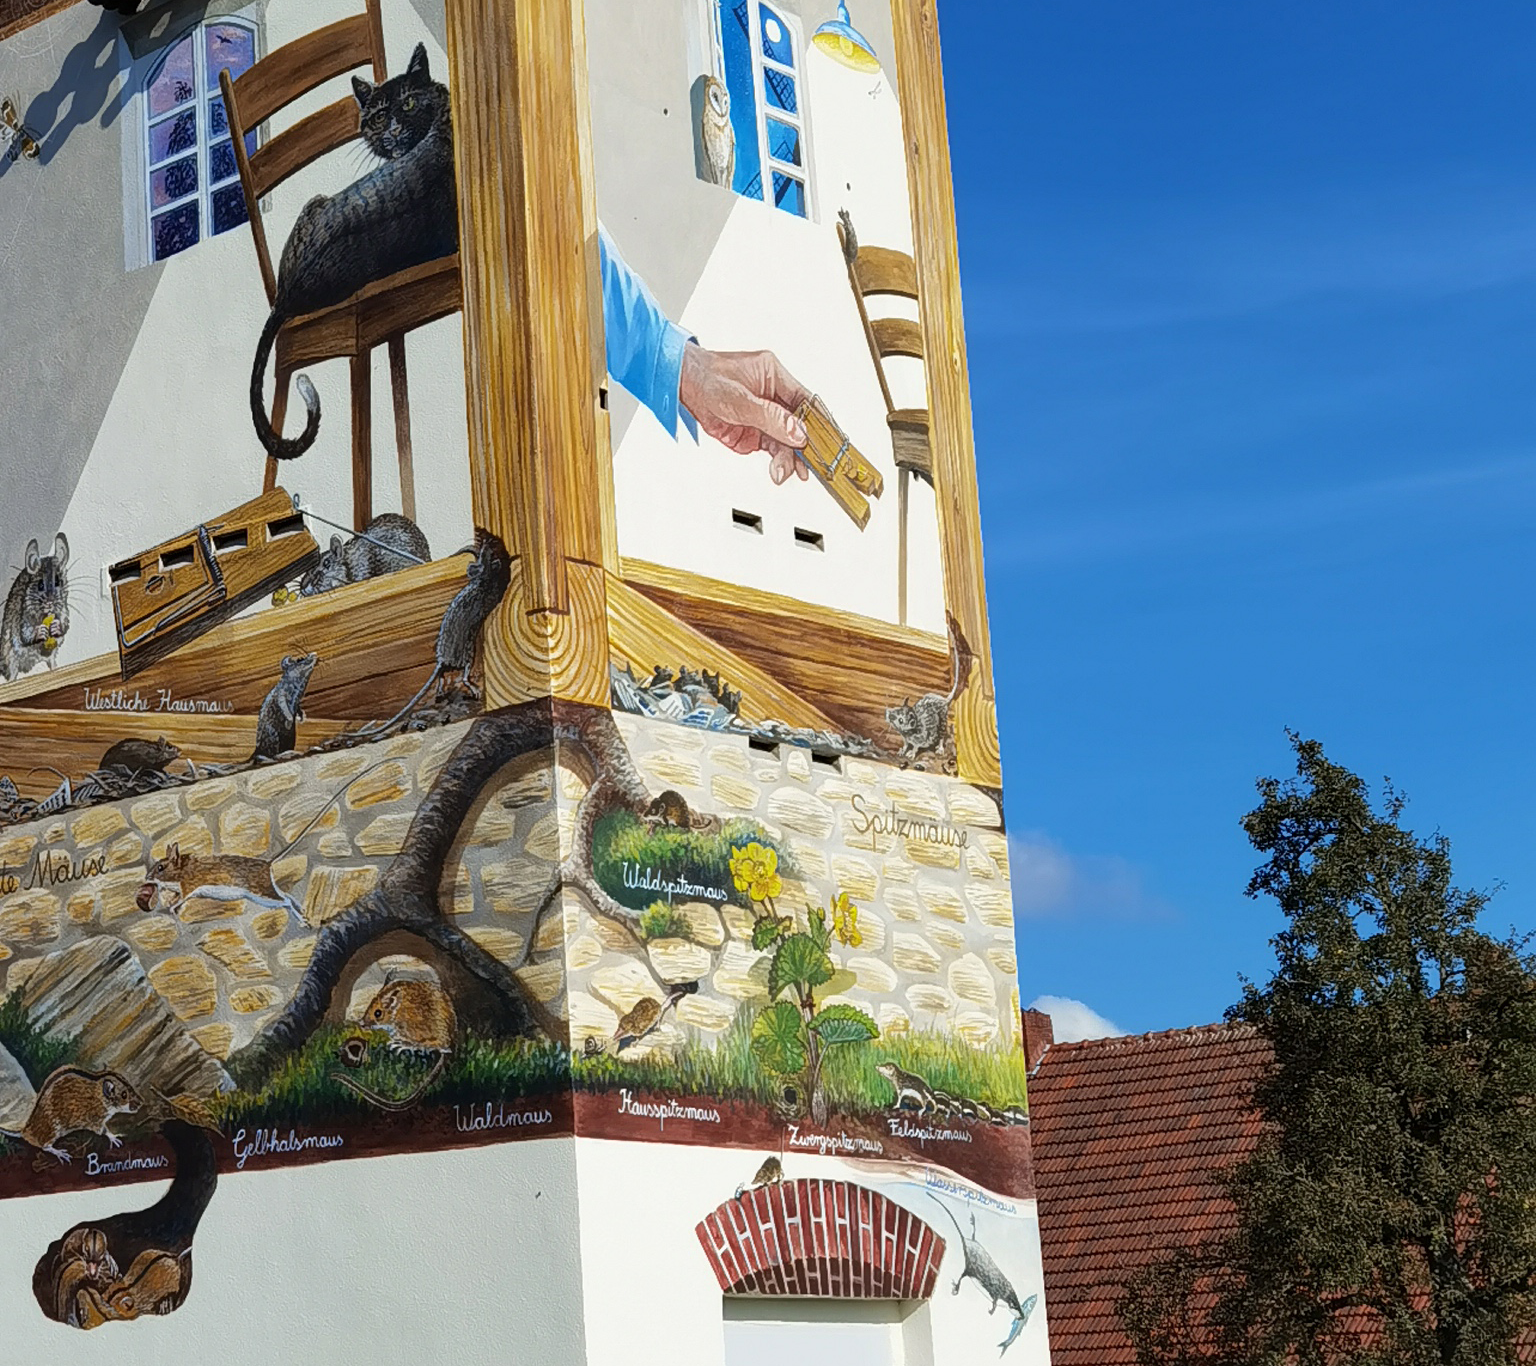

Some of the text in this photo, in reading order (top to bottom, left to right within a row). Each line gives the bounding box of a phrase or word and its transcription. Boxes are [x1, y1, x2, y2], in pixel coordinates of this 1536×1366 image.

[84, 688, 235, 713] Westliche Hausmaus
[851, 793, 971, 853] Spitzmäuse
[23, 849, 110, 891] Mäuse
[622, 861, 729, 904] Waldspitzmaus
[453, 1101, 554, 1132] Waldmaus
[617, 1088, 721, 1132] Hausspitzmaus
[232, 1128, 344, 1169] Gelbhalsmaus
[786, 1123, 885, 1156] Zwergspitzmaus
[886, 1118, 974, 1149] Feldspitzmaus
[84, 1151, 169, 1176] Brandmaus
